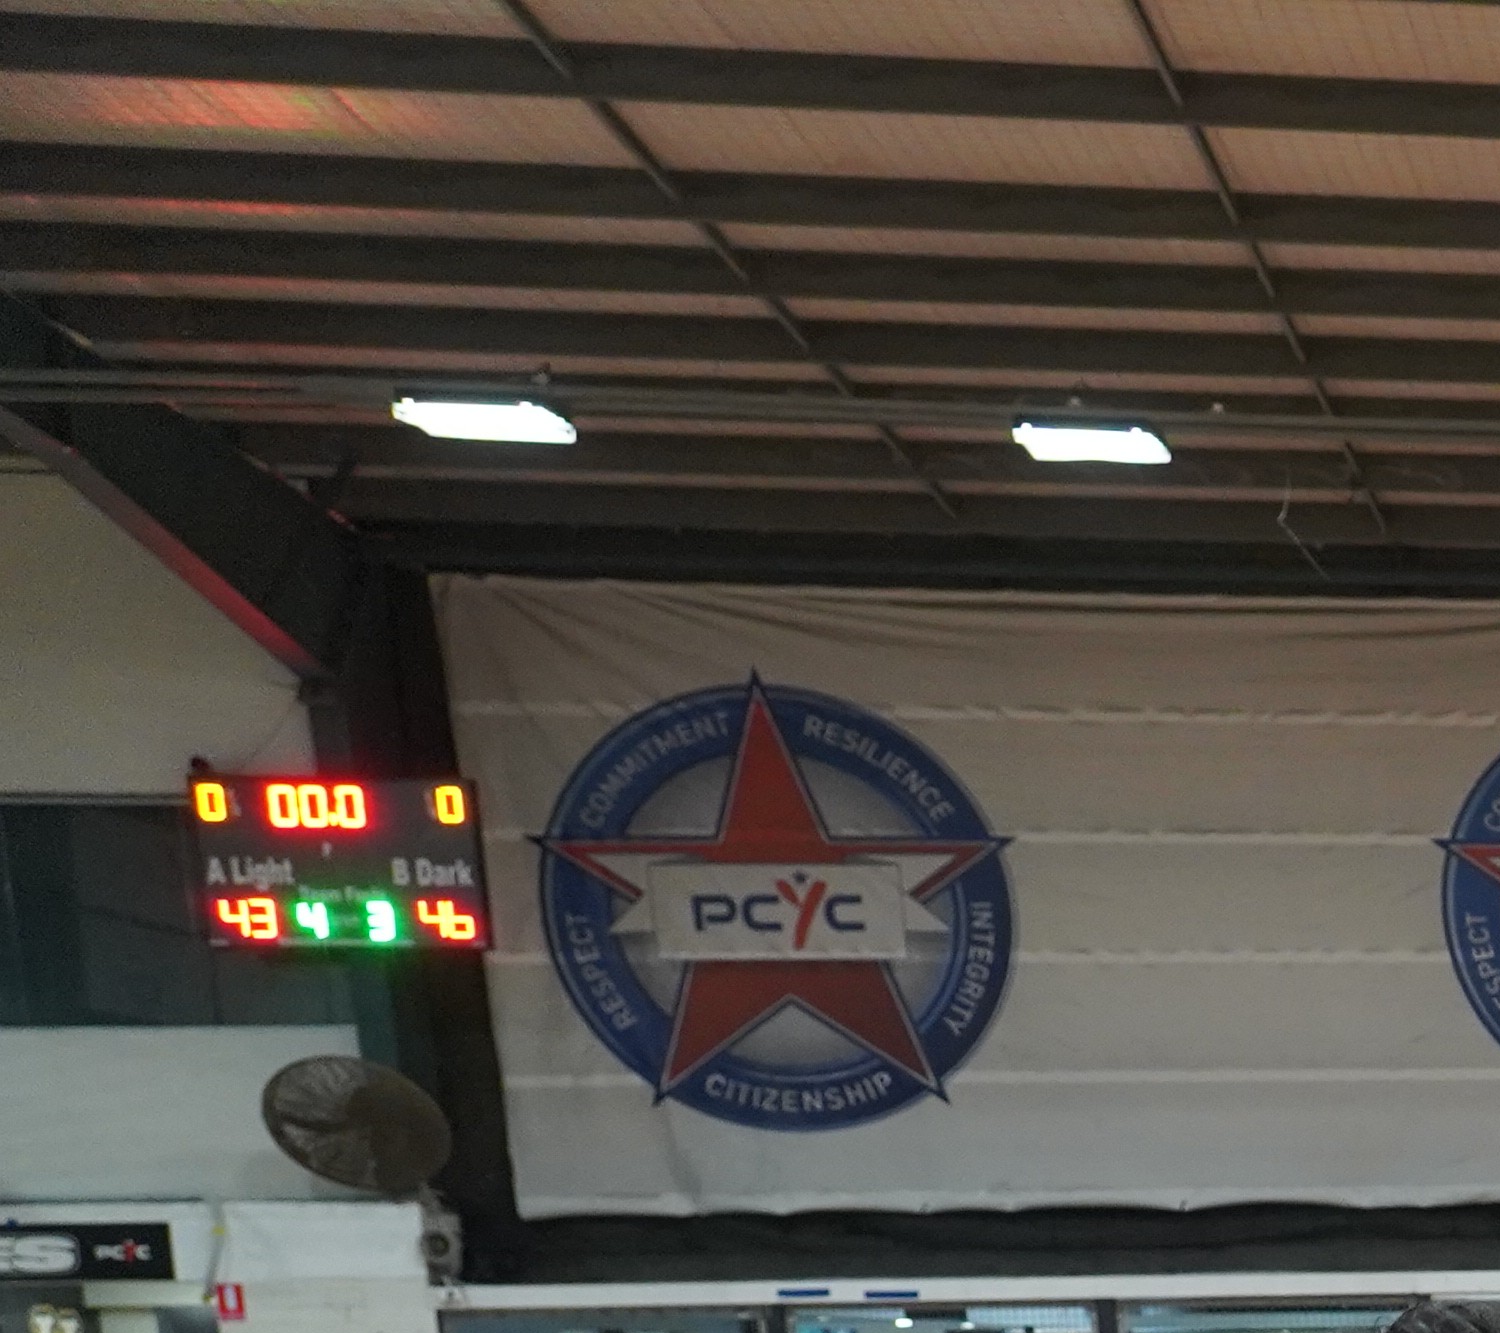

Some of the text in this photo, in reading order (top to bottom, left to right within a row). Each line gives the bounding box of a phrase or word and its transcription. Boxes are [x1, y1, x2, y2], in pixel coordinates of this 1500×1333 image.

[581, 713, 730, 828] COMMITMENT
[803, 714, 955, 824] RESILIENCE
[196, 783, 227, 822] 0
[435, 785, 465, 825] 0
[206, 857, 295, 893] A Light
[414, 857, 474, 886] Dark
[217, 897, 278, 939] 43
[295, 901, 329, 940] 4
[365, 900, 396, 942] 3
[690, 878, 865, 950] PCYC
[565, 912, 637, 1031] RESPECT
[944, 900, 995, 1037] INTEGRITY
[706, 1072, 893, 1113] CITIZENSHIP
[0, 1236, 76, 1274] S
